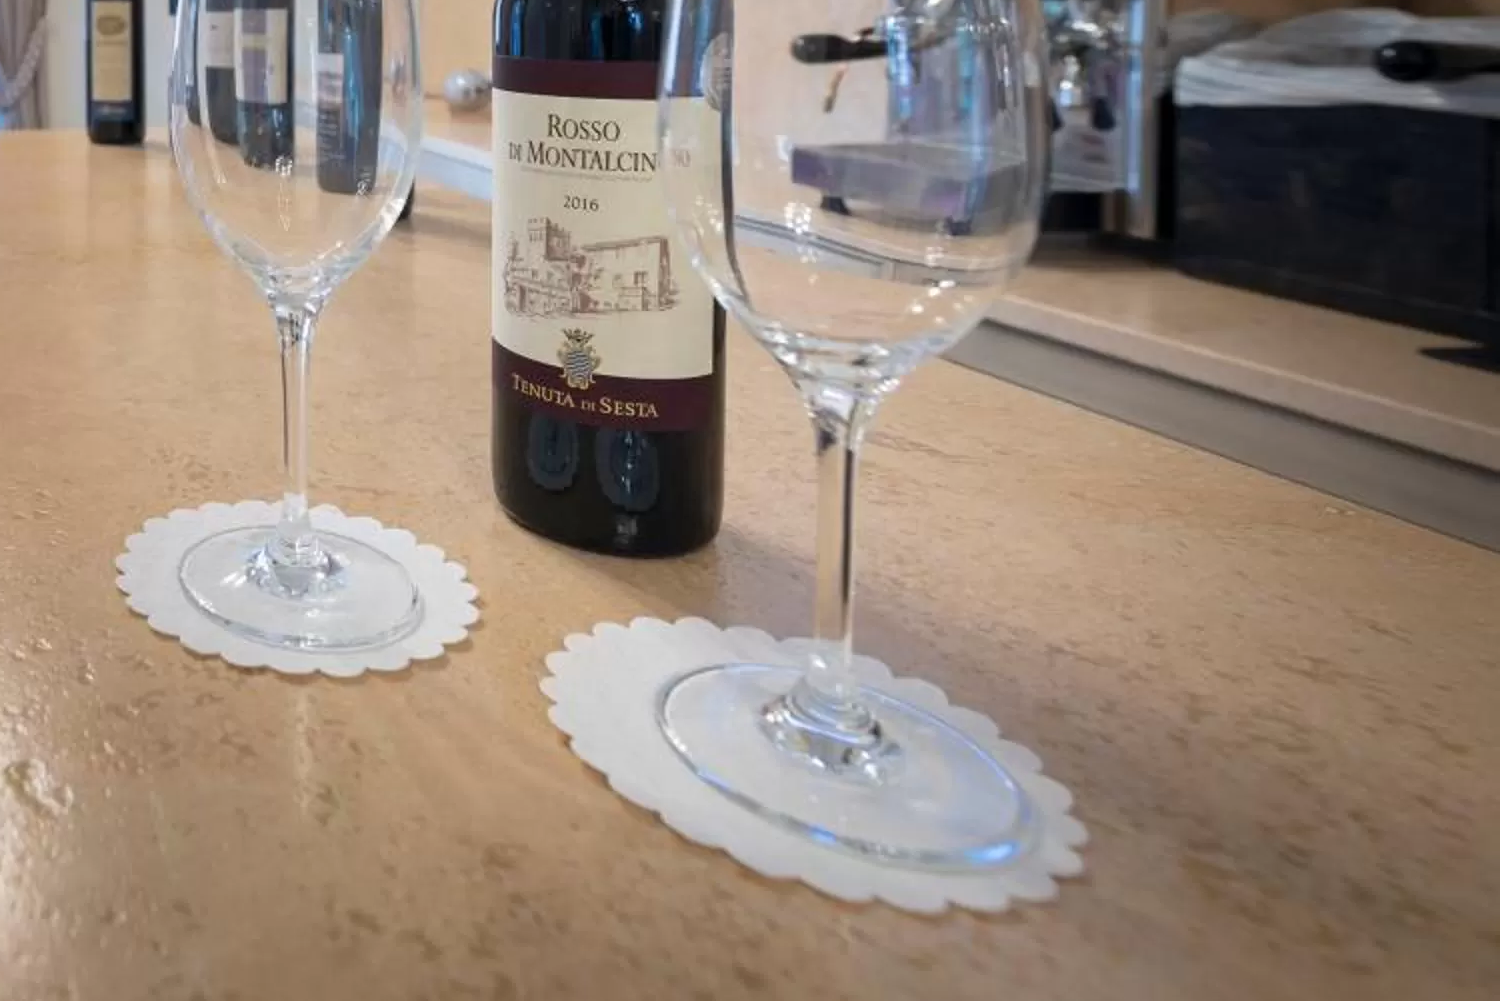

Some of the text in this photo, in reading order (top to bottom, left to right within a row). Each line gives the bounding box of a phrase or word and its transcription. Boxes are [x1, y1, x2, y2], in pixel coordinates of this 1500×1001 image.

[547, 113, 621, 142] ROSSO
[508, 139, 661, 173] DI MONTALCIN
[563, 195, 599, 212] 2016
[512, 372, 659, 418] TENUTA DI SESTA
